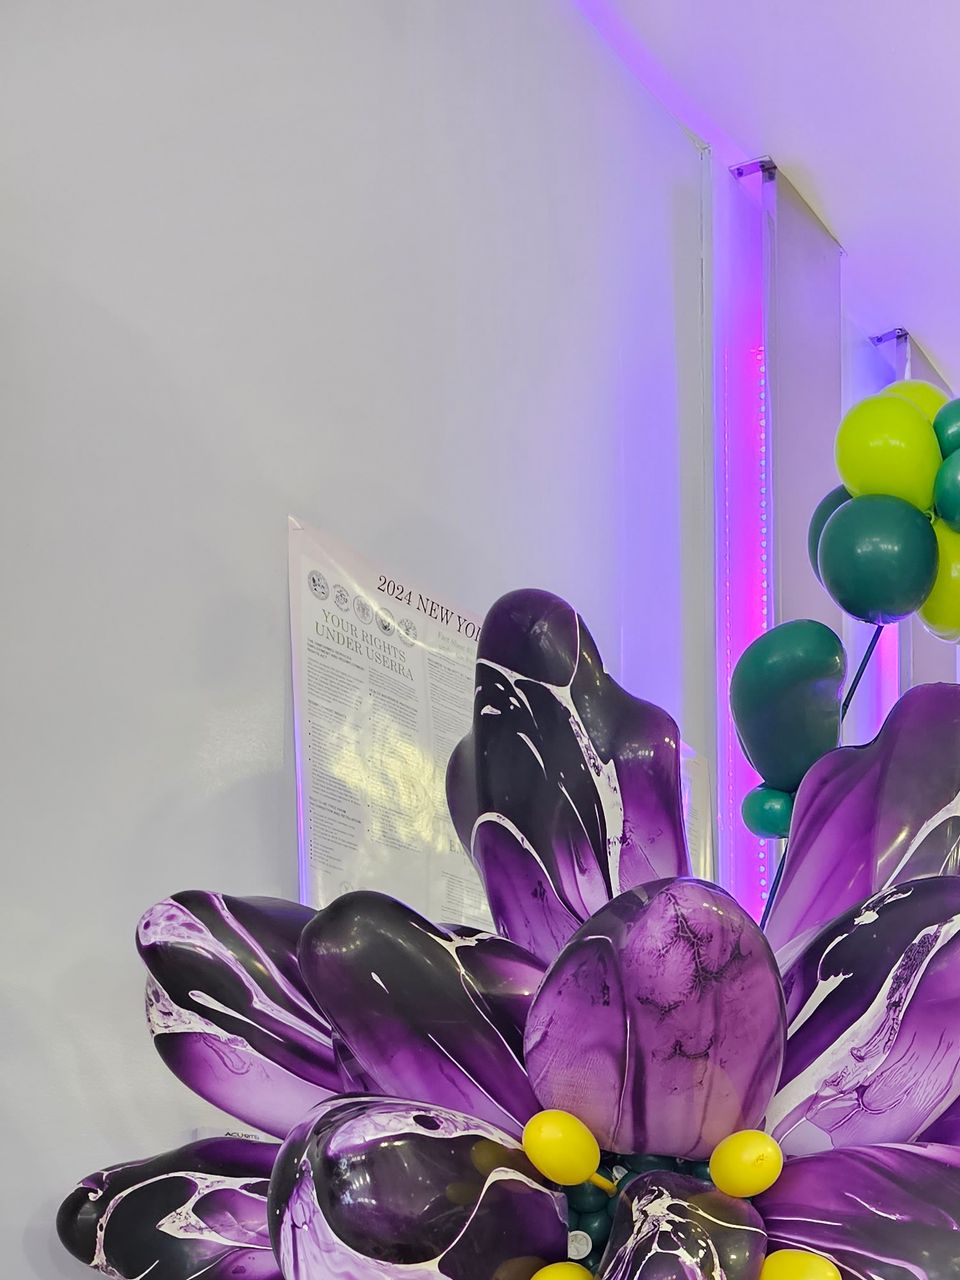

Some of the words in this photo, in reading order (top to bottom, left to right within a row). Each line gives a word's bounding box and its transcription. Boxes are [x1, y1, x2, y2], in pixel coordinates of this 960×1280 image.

[322, 608, 358, 639] YOUR
[361, 630, 406, 663] RIGHTS
[377, 575, 412, 606] 2024
[416, 594, 454, 625] NEW
[456, 615, 482, 642] YO
[315, 621, 363, 656] UNDER
[366, 646, 414, 681] USERRA
